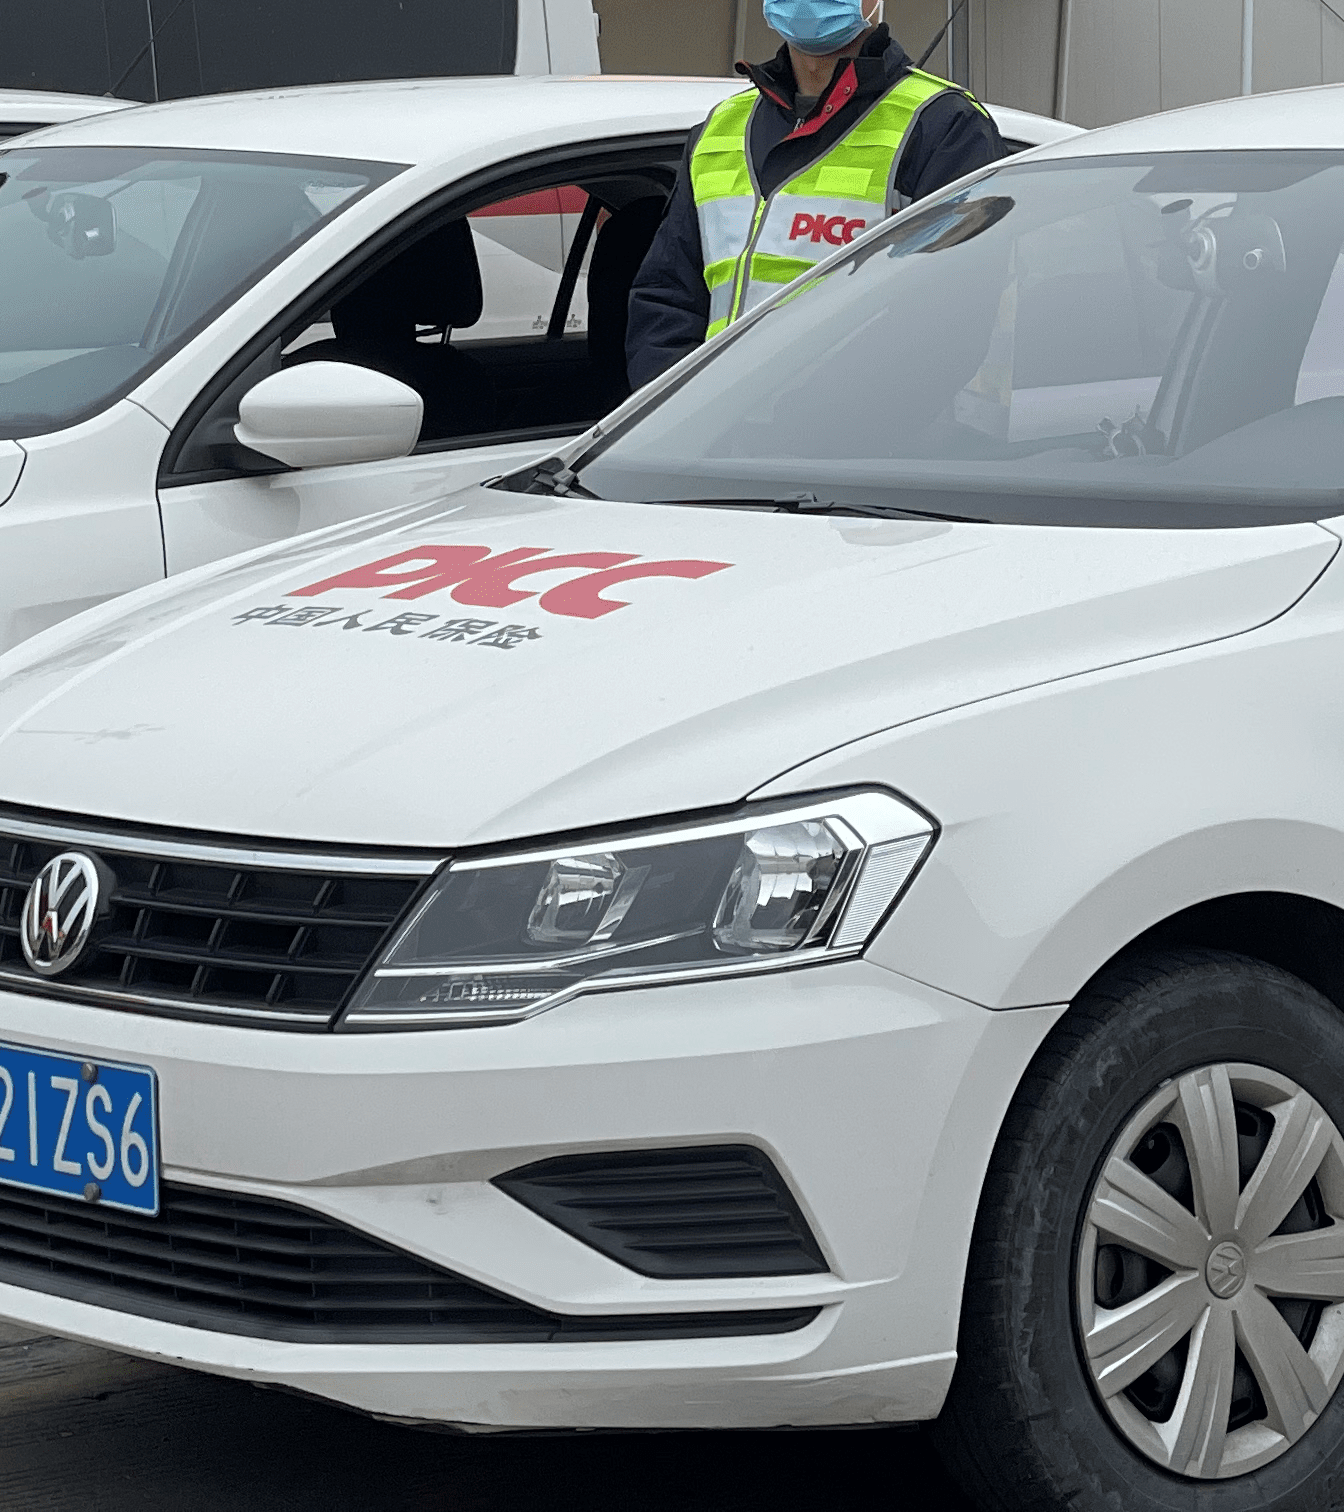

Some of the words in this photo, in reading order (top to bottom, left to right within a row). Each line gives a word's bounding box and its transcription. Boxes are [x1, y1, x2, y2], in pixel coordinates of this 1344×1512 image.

[788, 212, 866, 246] PICC
[281, 544, 736, 620] PICC
[229, 604, 544, 650] 中国人民保险
